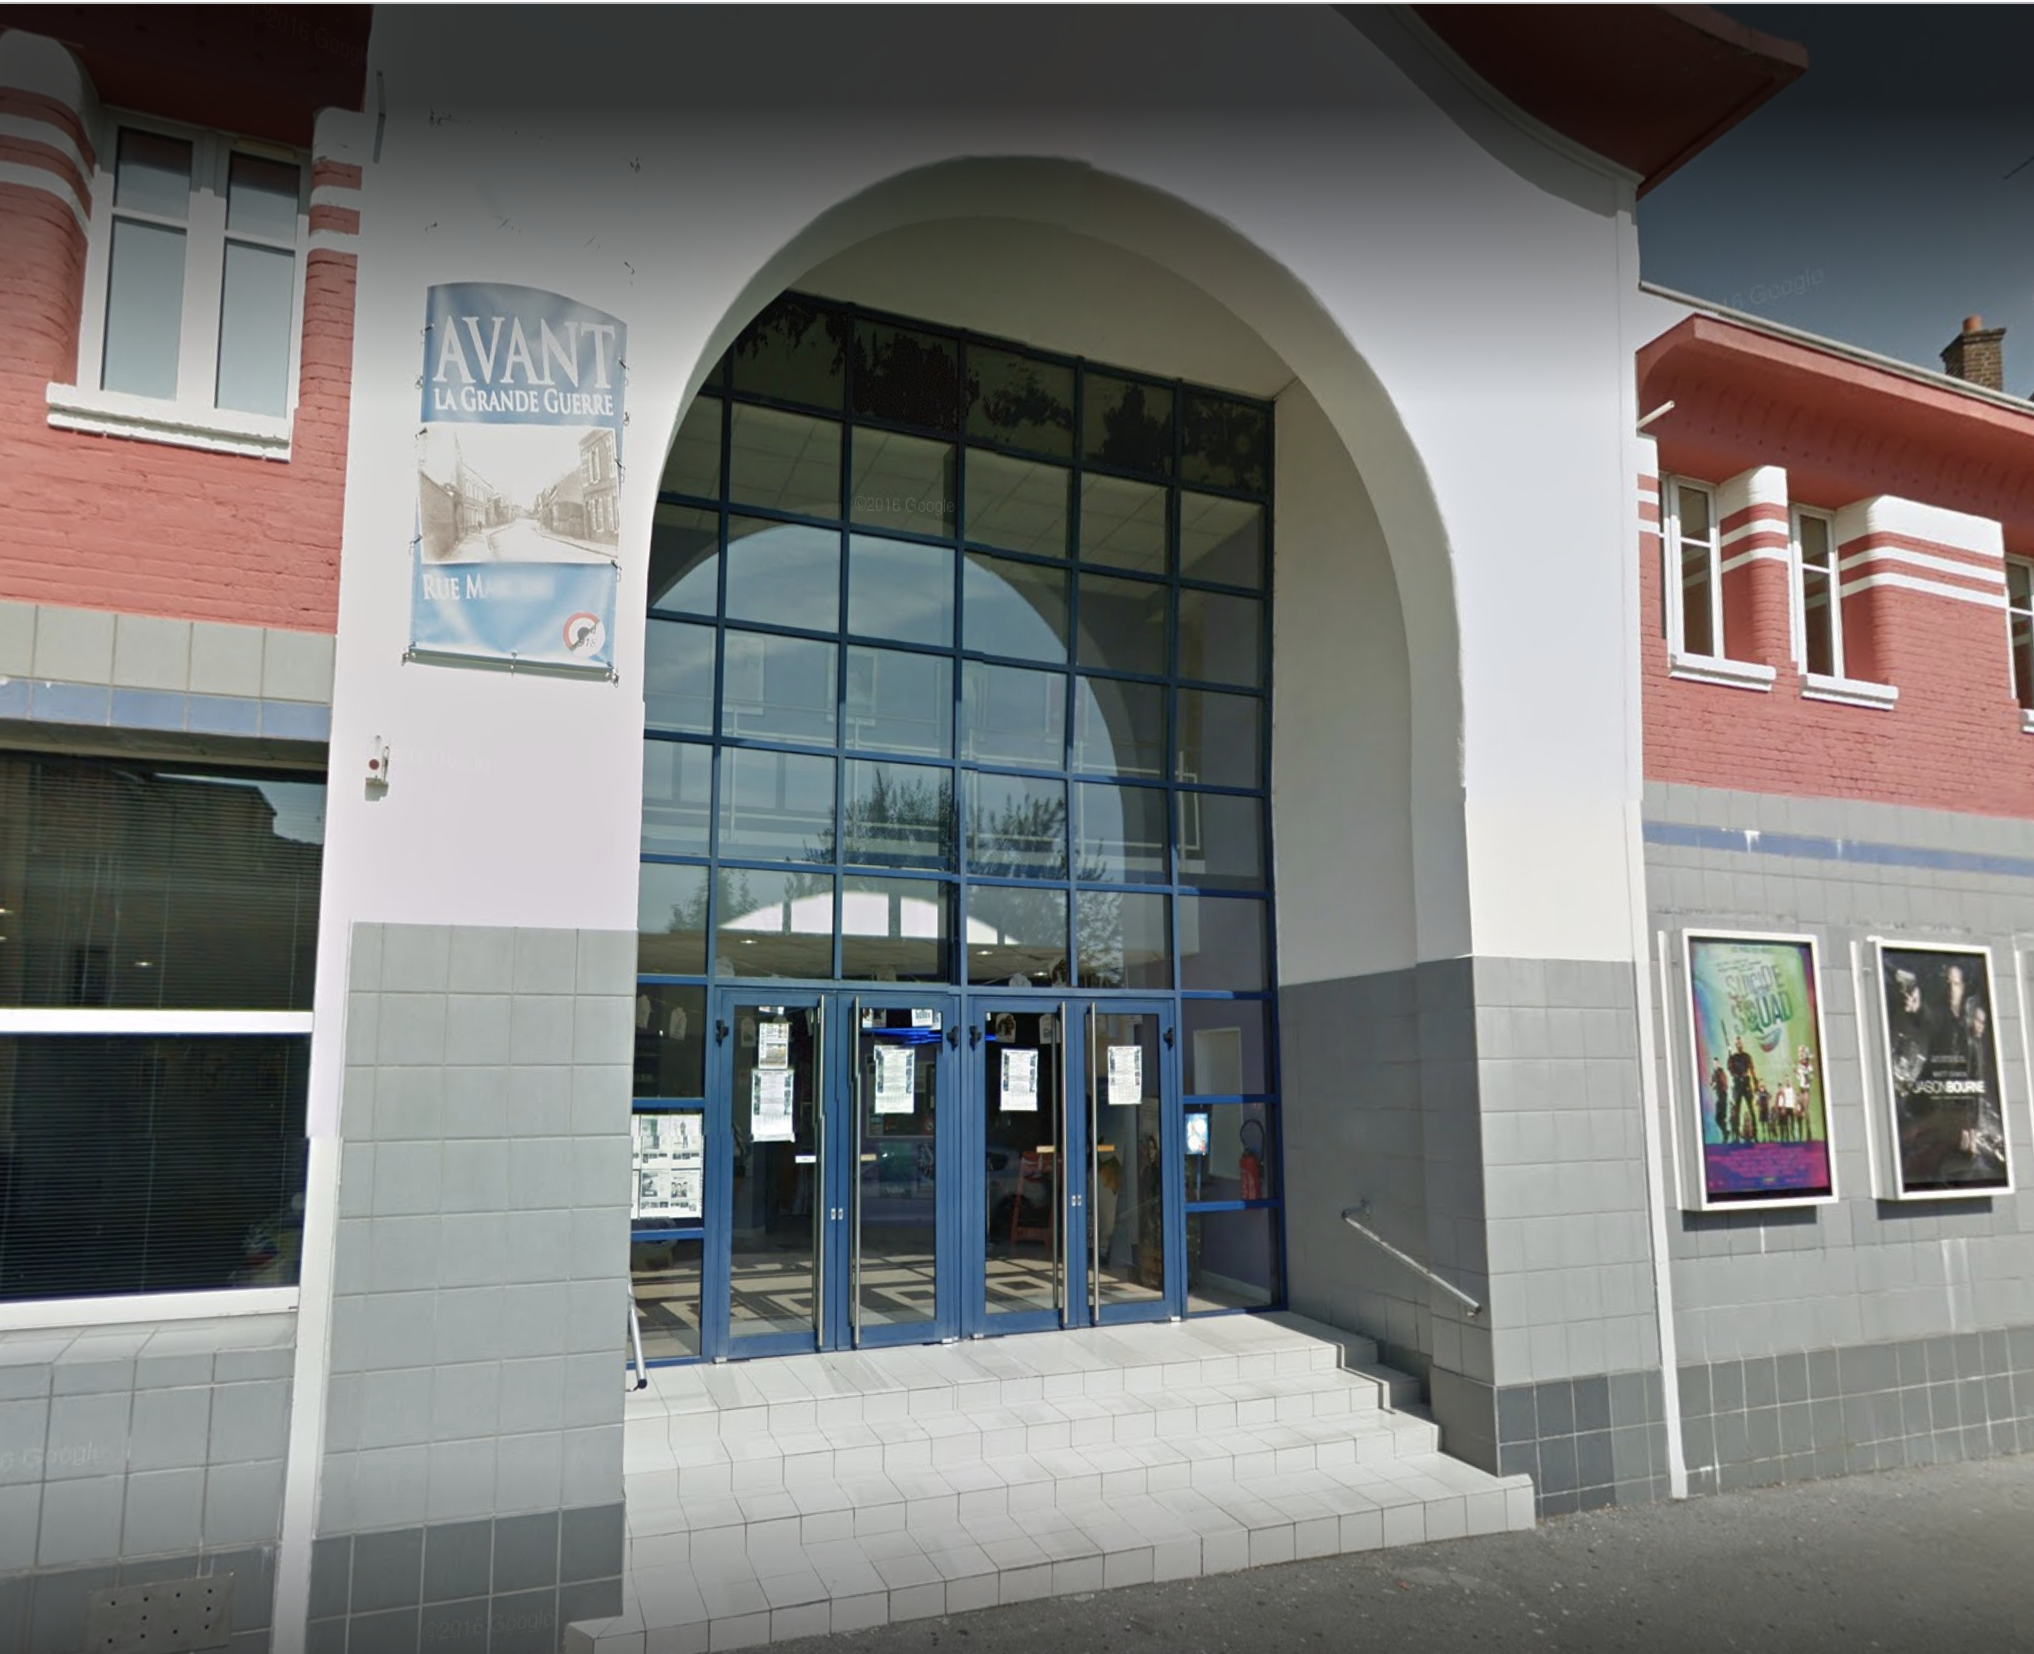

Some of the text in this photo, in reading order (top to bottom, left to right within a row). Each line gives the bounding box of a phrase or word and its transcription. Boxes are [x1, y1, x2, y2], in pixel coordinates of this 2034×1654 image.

[432, 315, 616, 389] AVANT
[460, 386, 540, 413] GRANDE
[543, 387, 615, 416] GUERRE
[422, 573, 460, 600] RUE
[1730, 991, 1793, 1035] SQUAD
